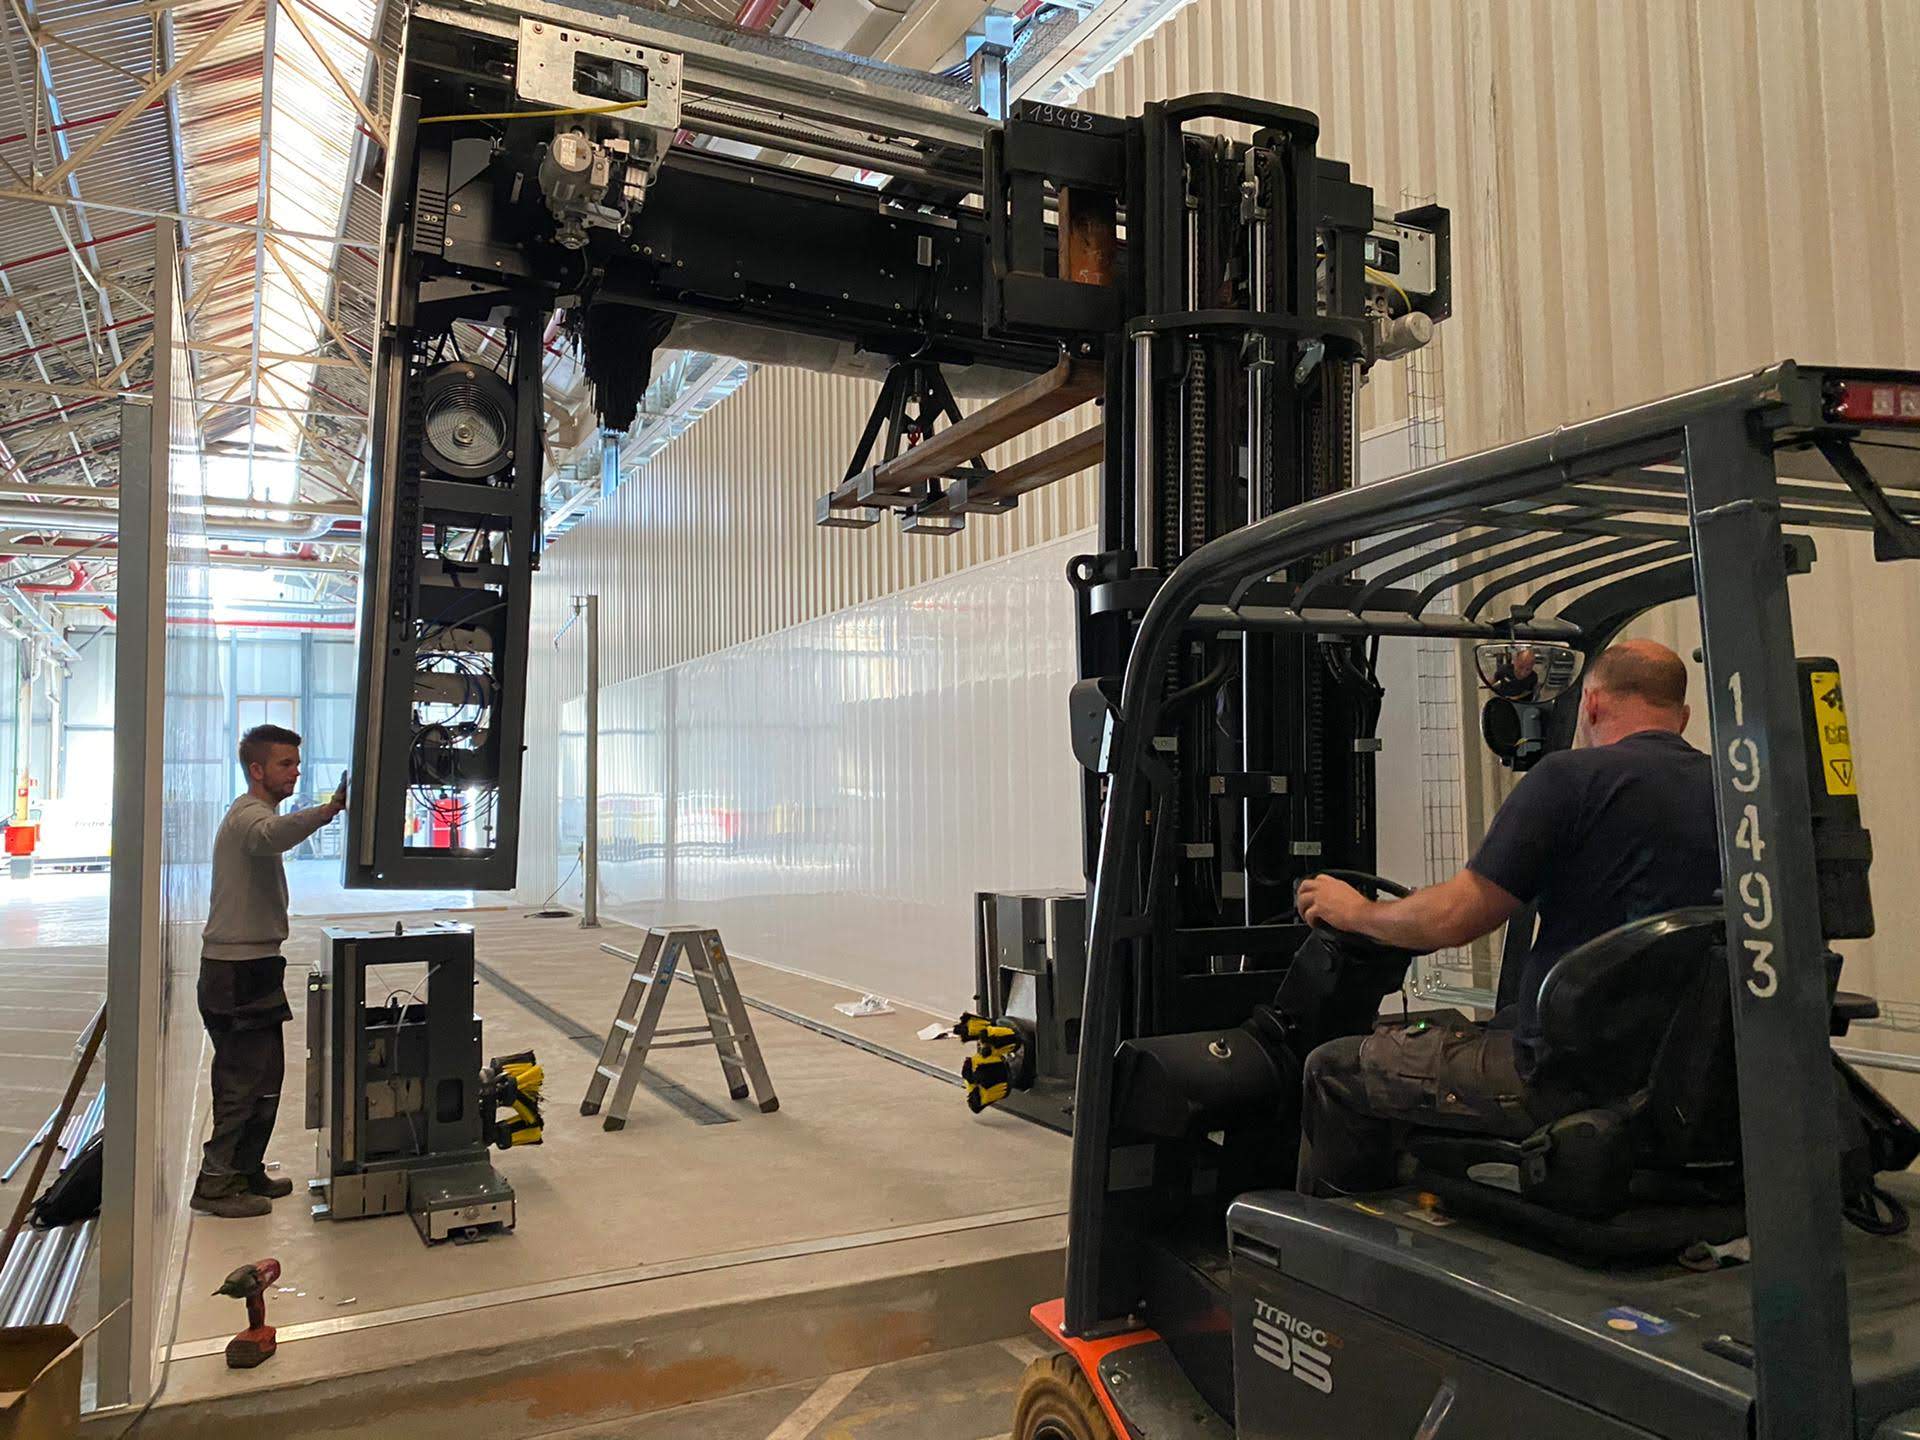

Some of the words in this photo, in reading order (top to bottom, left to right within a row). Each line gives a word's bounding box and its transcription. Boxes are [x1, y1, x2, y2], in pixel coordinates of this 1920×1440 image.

[1029, 104, 1093, 131] 19493
[1727, 671, 1778, 998] 19493
[1252, 1318, 1334, 1394] 35
